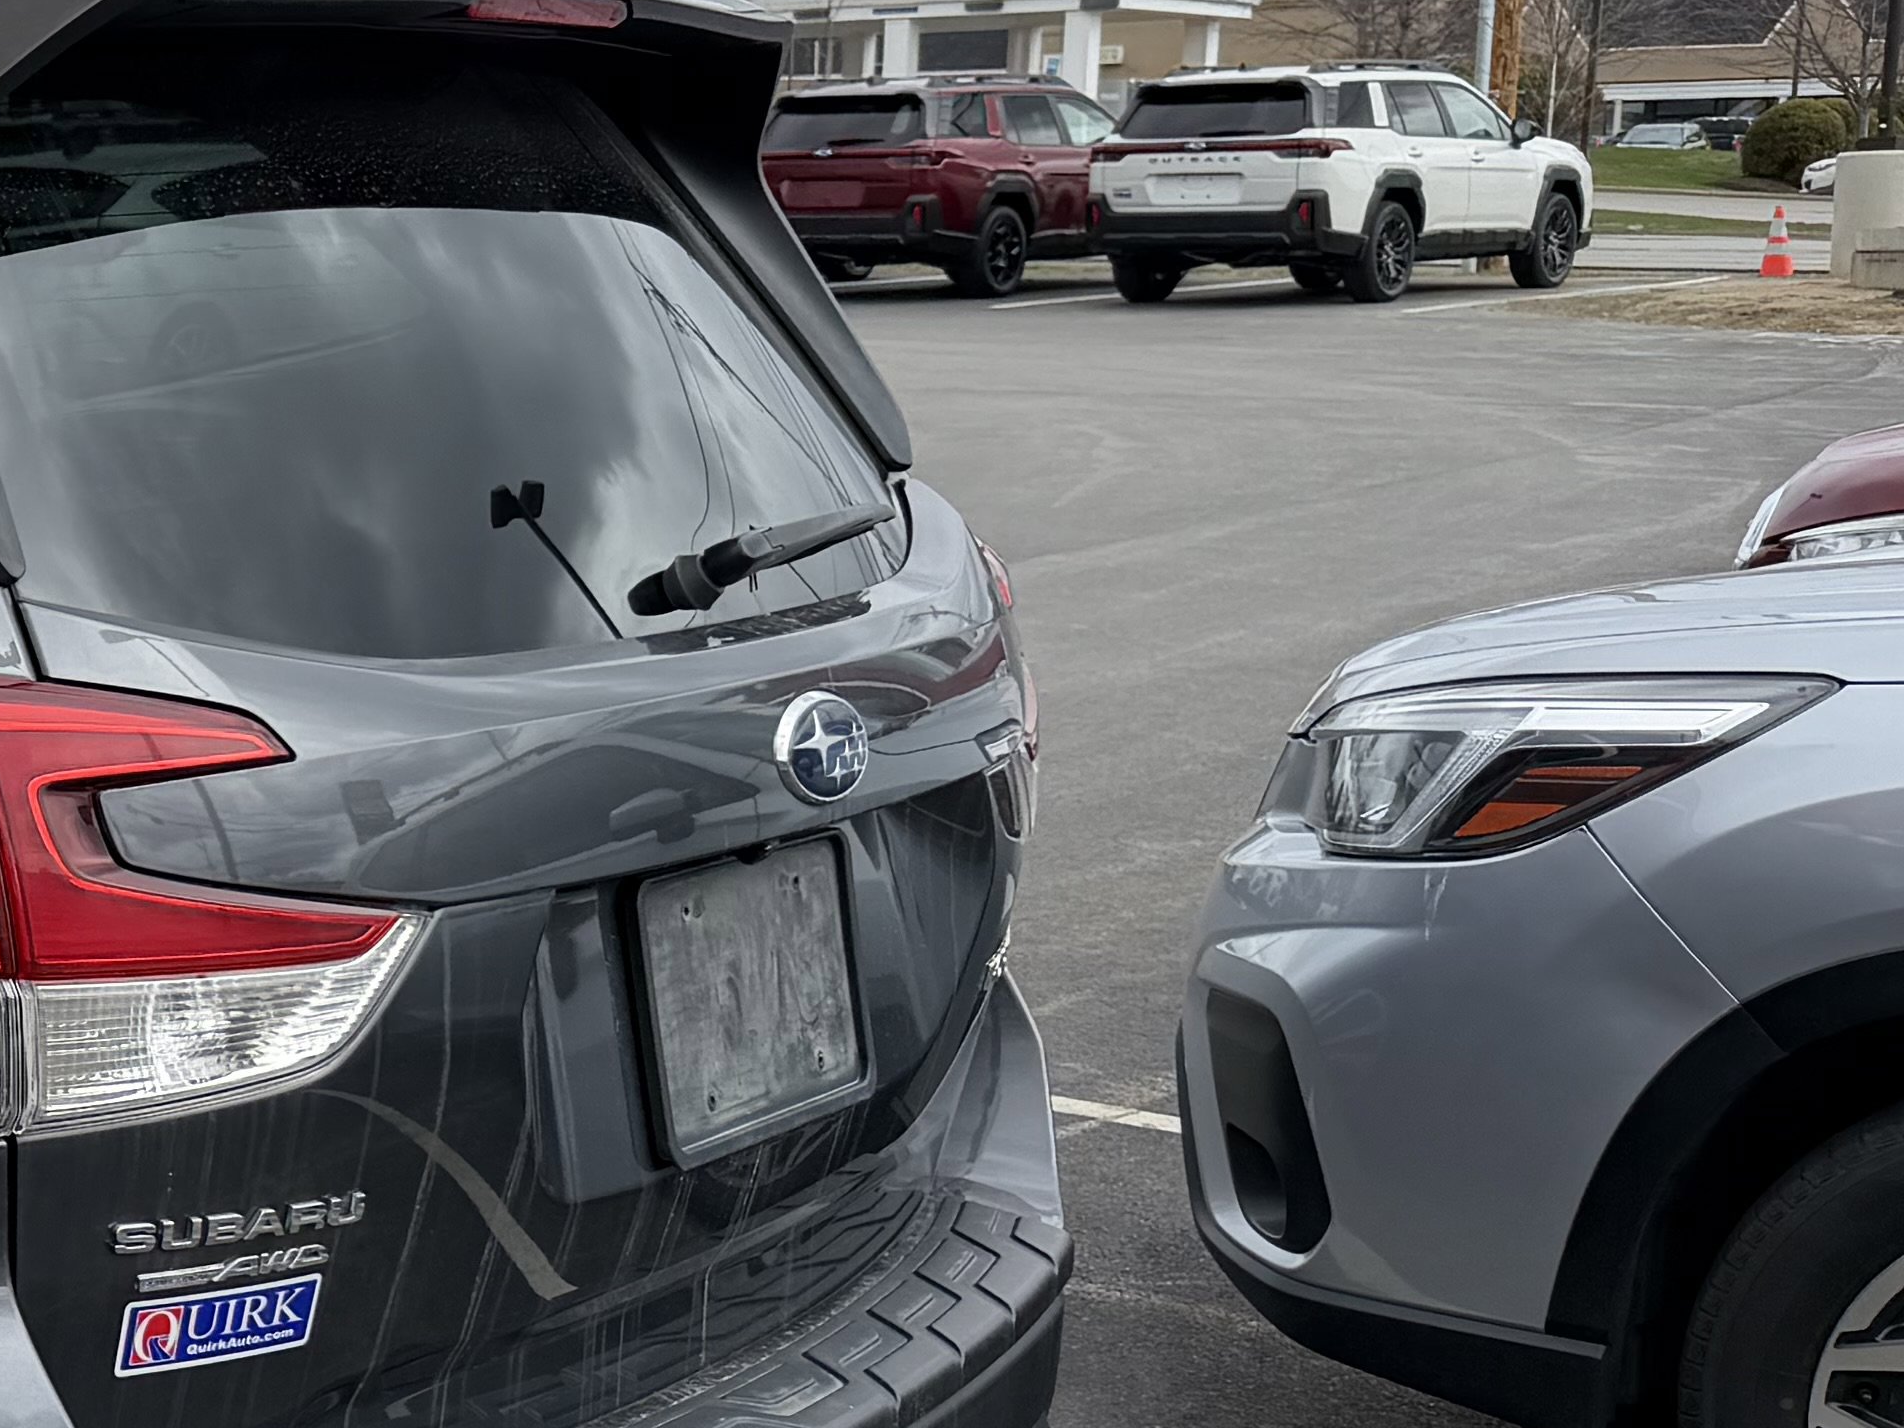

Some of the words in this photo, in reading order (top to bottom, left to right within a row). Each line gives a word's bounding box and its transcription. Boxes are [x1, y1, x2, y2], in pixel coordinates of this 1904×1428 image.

[1148, 156, 1241, 164] OUTBACK
[109, 1191, 366, 1254] SUBARU
[212, 1244, 330, 1282] AWD
[134, 1287, 306, 1361] QUIRK
[186, 1328, 294, 1355] QuirkAuto.com
